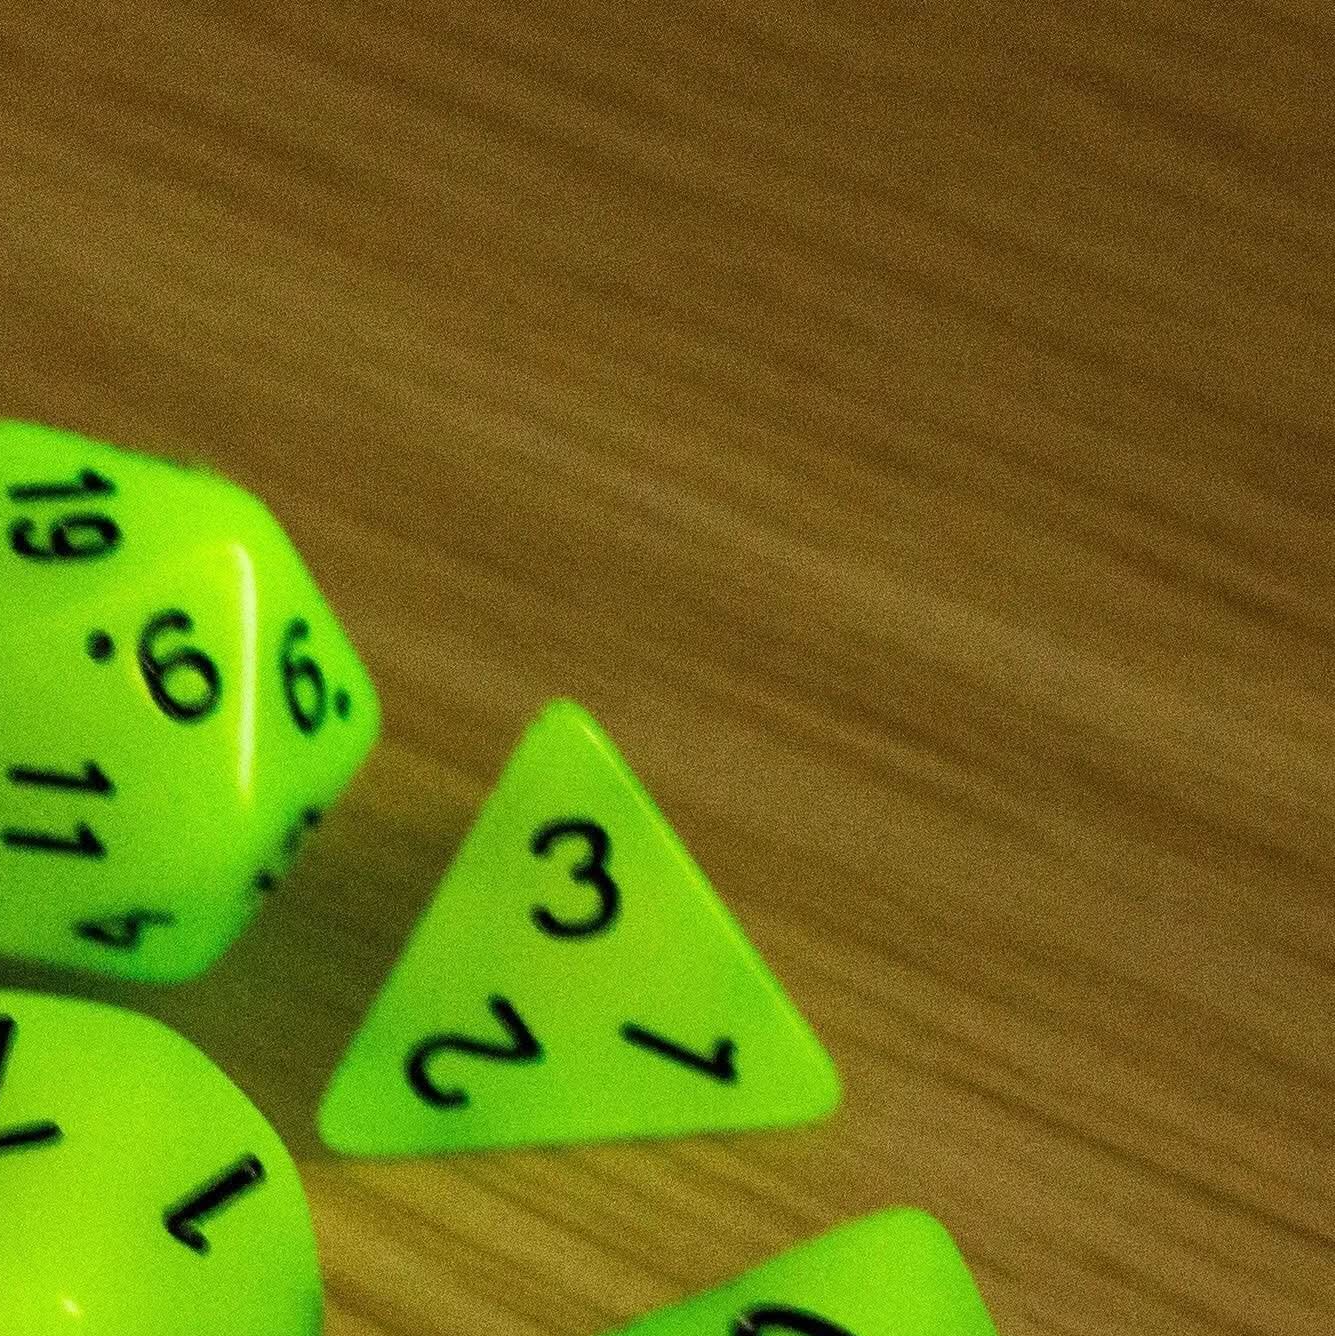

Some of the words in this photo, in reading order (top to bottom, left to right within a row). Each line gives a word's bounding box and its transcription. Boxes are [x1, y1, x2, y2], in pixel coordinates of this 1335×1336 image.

[6, 469, 122, 566] 19
[0, 761, 115, 861] 11
[528, 816, 622, 942] 3
[402, 994, 544, 1112] 2
[619, 1022, 739, 1086] 1
[162, 1154, 266, 1255] 1
